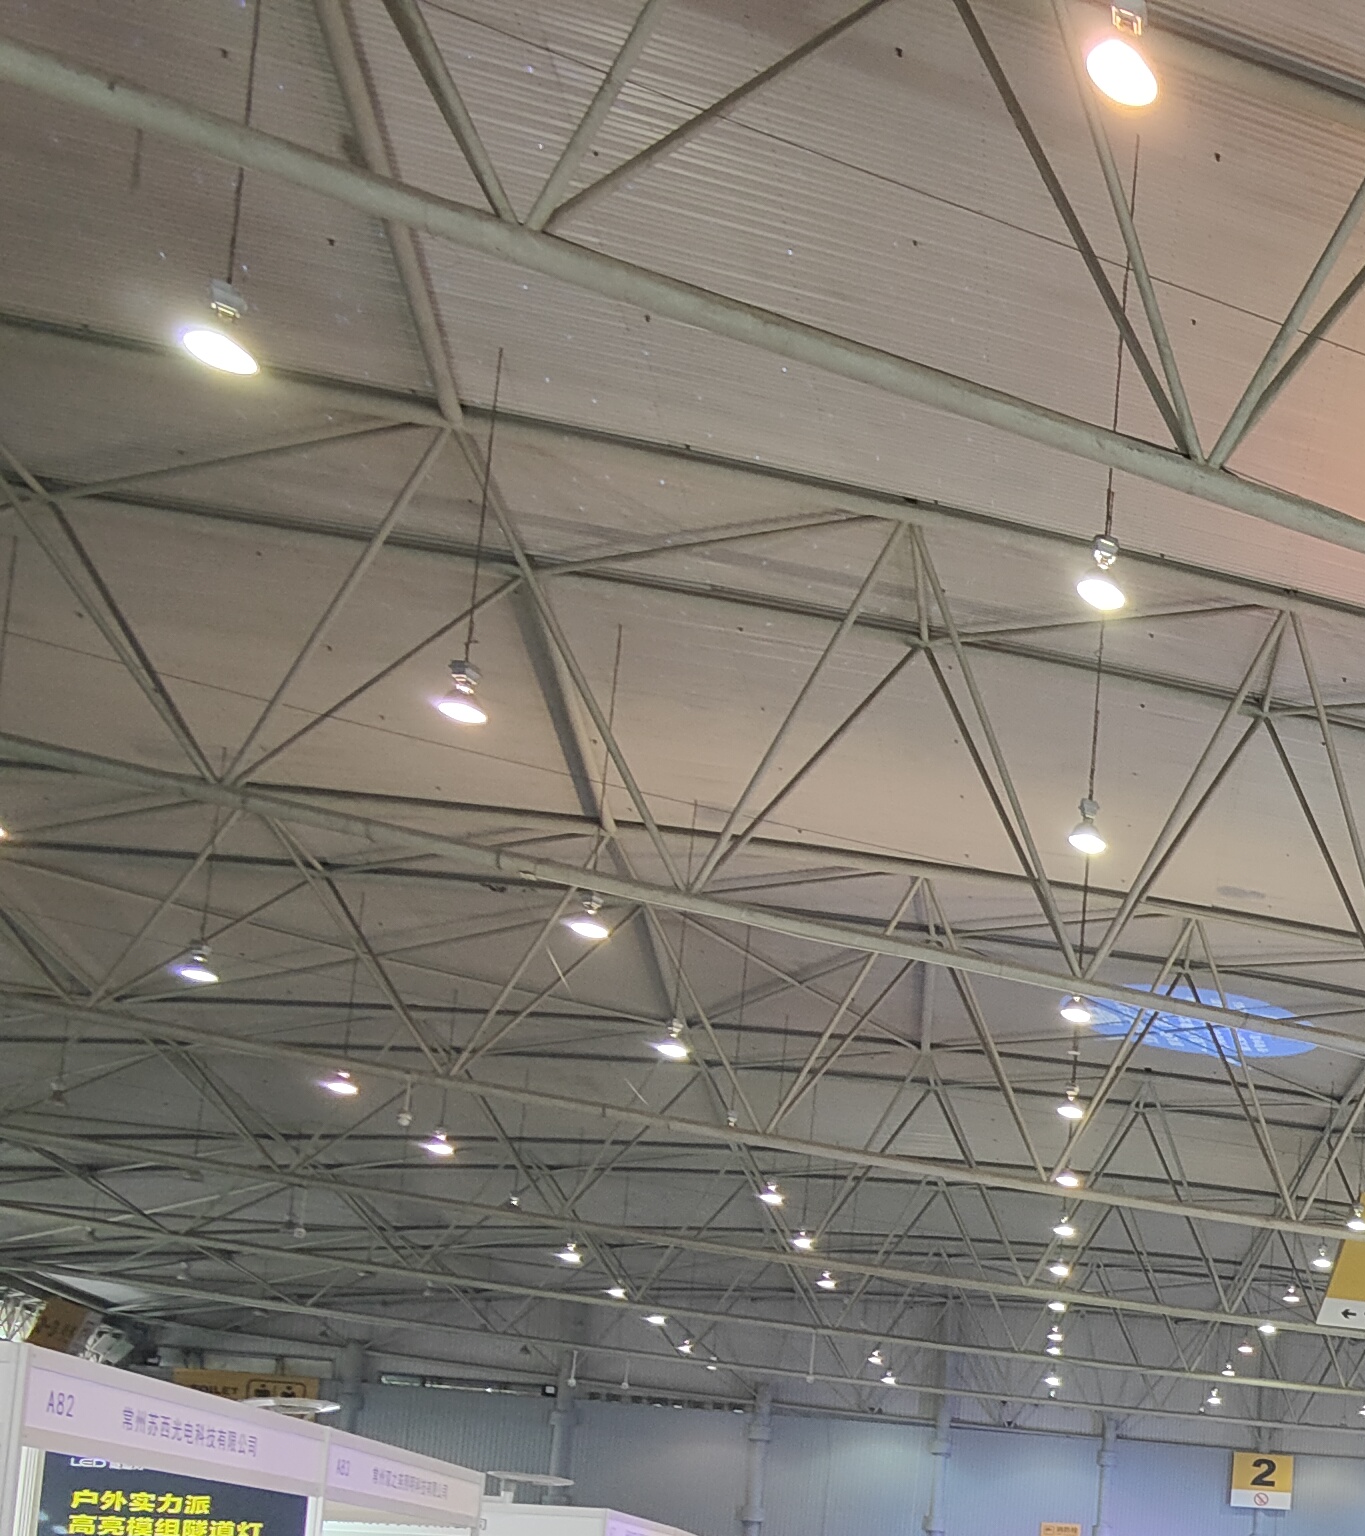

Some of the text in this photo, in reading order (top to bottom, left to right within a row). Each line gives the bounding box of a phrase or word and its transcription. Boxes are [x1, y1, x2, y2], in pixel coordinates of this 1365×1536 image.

[46, 1390, 75, 1418] A82
[122, 1406, 258, 1457] 常州苏西光电科技有限公司
[71, 1457, 107, 1468] LED
[1250, 1458, 1277, 1487] 2
[71, 1488, 212, 1515] 户外实力派
